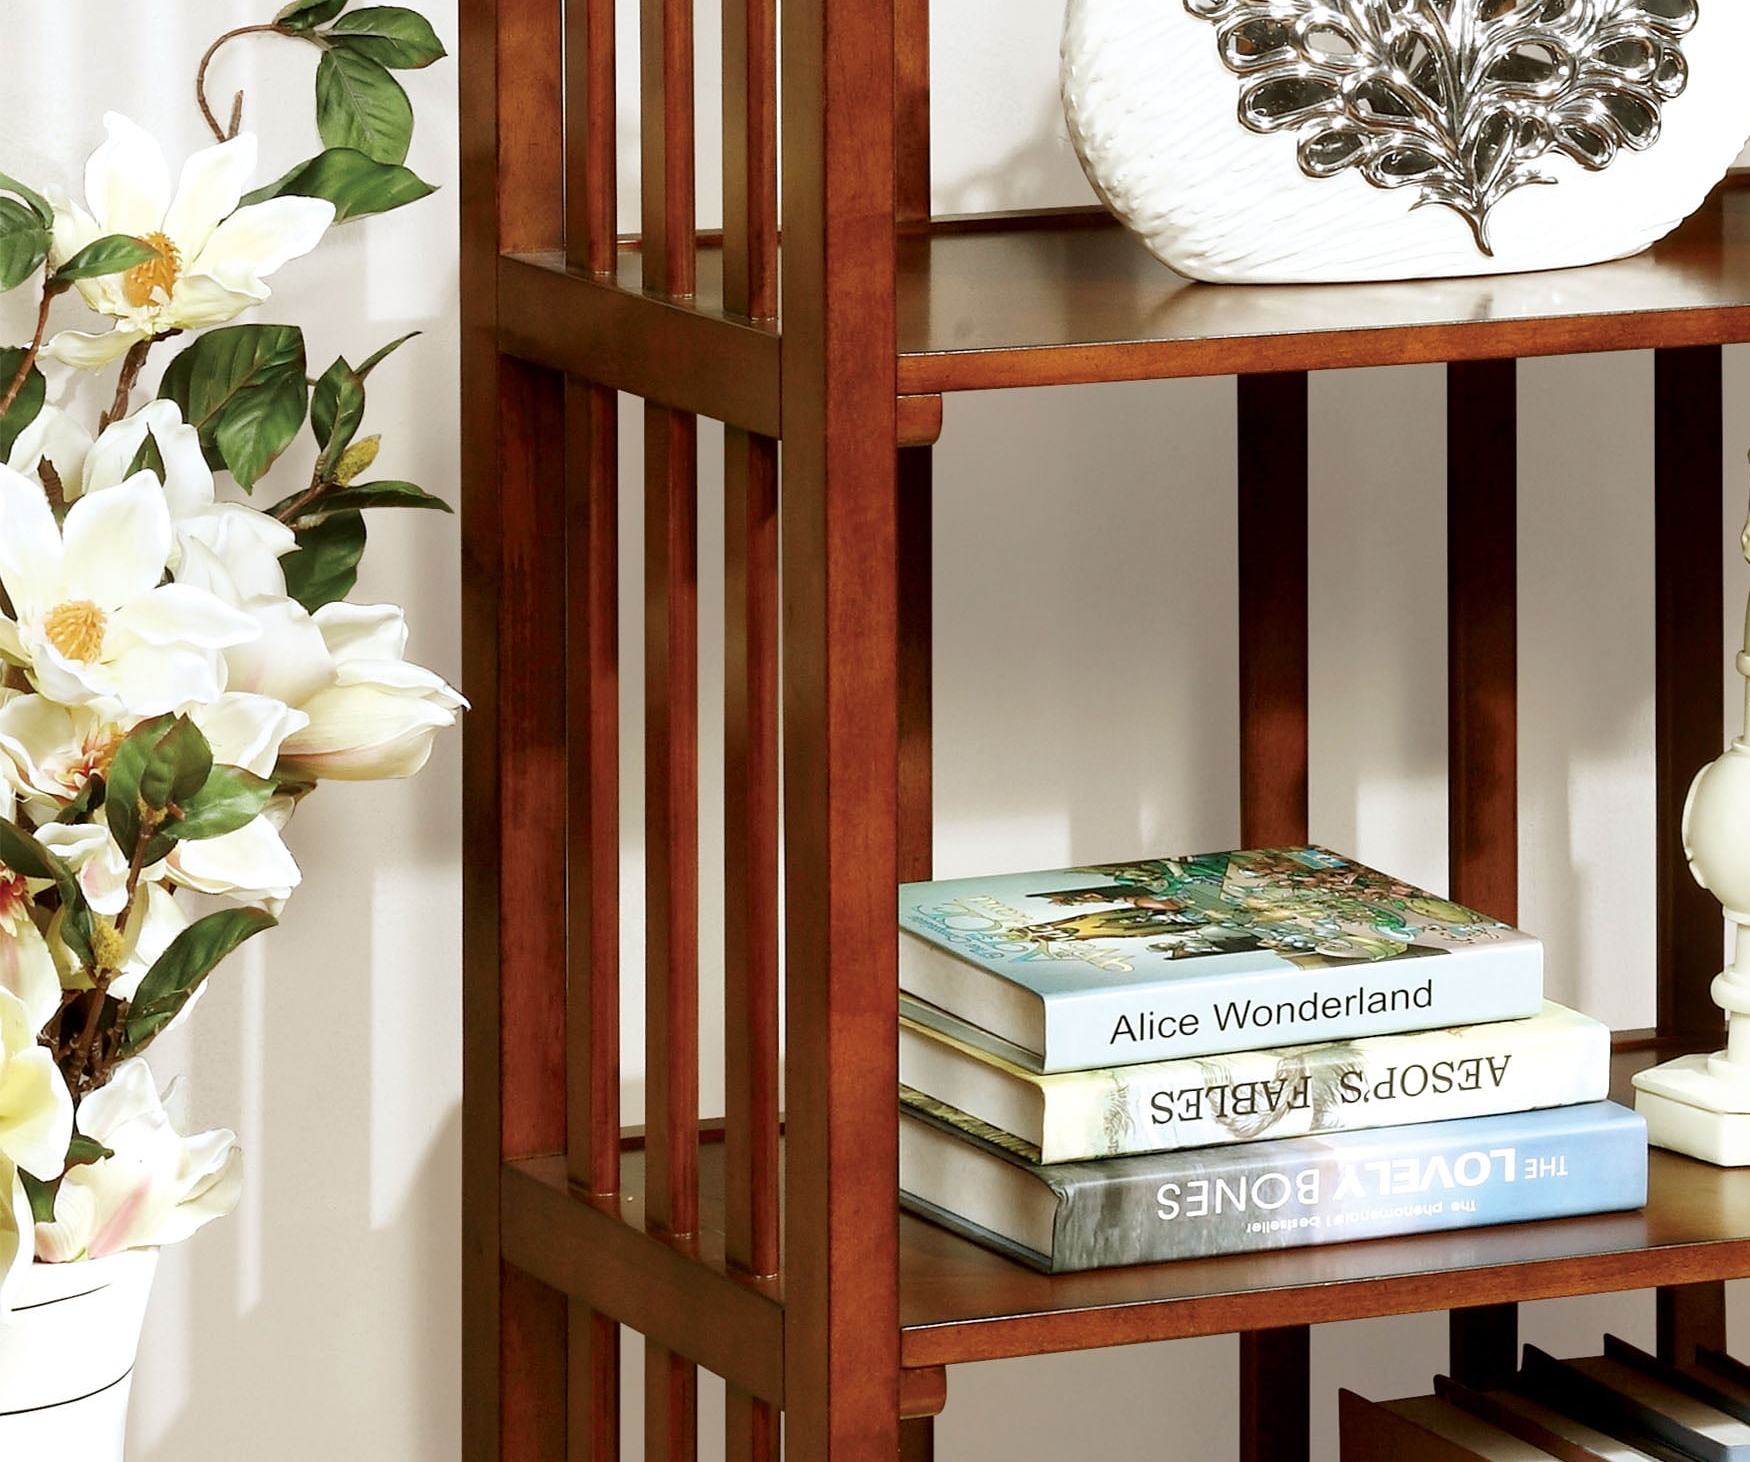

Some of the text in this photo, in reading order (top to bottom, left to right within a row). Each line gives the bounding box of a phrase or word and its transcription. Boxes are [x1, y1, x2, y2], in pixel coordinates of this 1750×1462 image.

[1109, 979, 1433, 1044] Alice Wonderland
[1151, 1054, 1512, 1125] AESOP'S FABLES
[1156, 1148, 1569, 1220] THE LOVELY BONES
[1451, 1200, 1477, 1215] The
